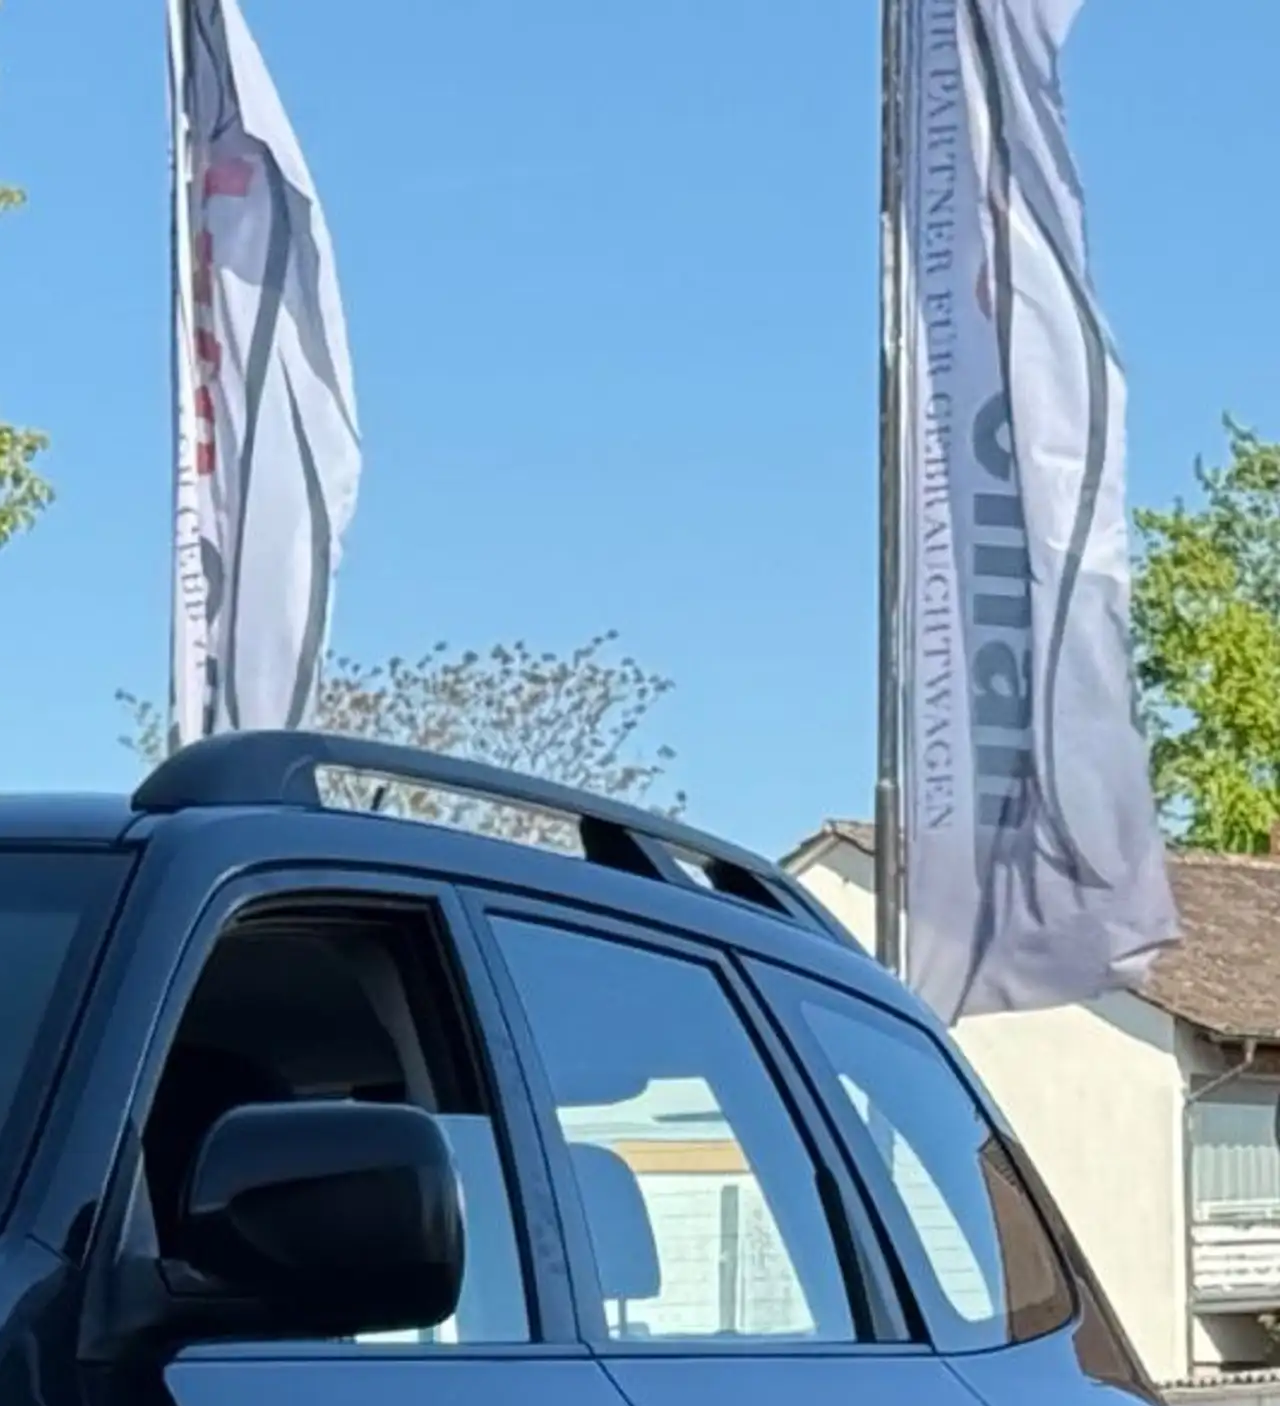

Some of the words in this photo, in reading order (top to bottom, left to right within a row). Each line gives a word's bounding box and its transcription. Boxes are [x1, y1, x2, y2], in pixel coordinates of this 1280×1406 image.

[929, 0, 957, 52] HR
[925, 66, 959, 275] PARTNER
[926, 289, 958, 377] FÜR
[921, 391, 955, 830] GEBRAUCHTWAGEN
